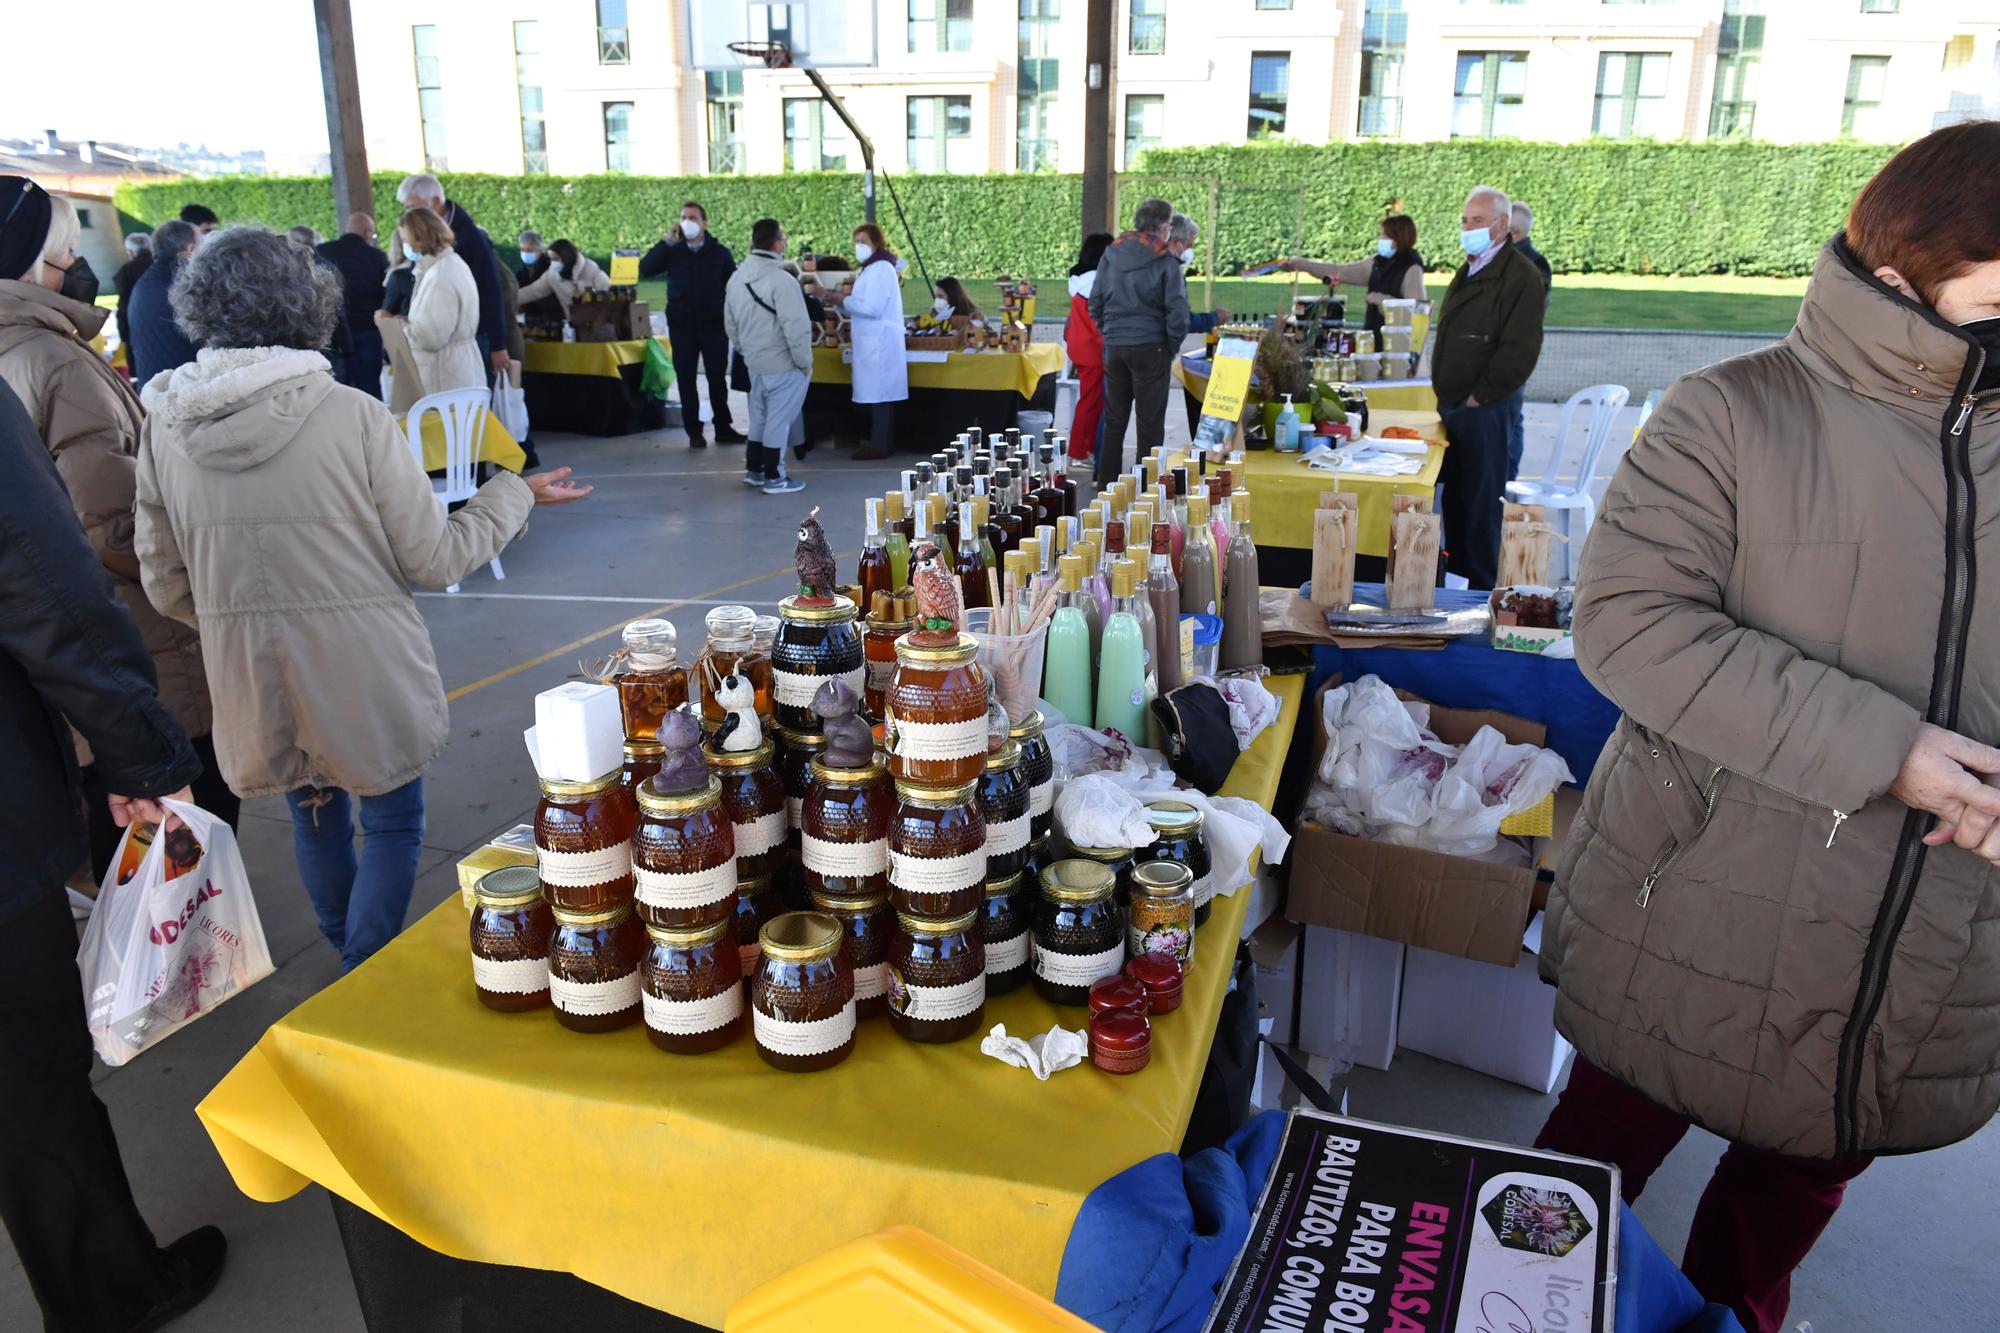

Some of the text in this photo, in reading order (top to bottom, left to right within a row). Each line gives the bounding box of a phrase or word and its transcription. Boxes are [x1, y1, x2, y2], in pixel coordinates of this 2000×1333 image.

[200, 916, 240, 947] LICORES
[1260, 1172, 1294, 1253] www.licorescodesal.com
[1285, 1135, 1361, 1248] BAUTIZOS,
[1500, 1190, 1517, 1240] CODESAL
[1341, 1201, 1396, 1274] PARA
[1542, 1274, 1584, 1333] lico
